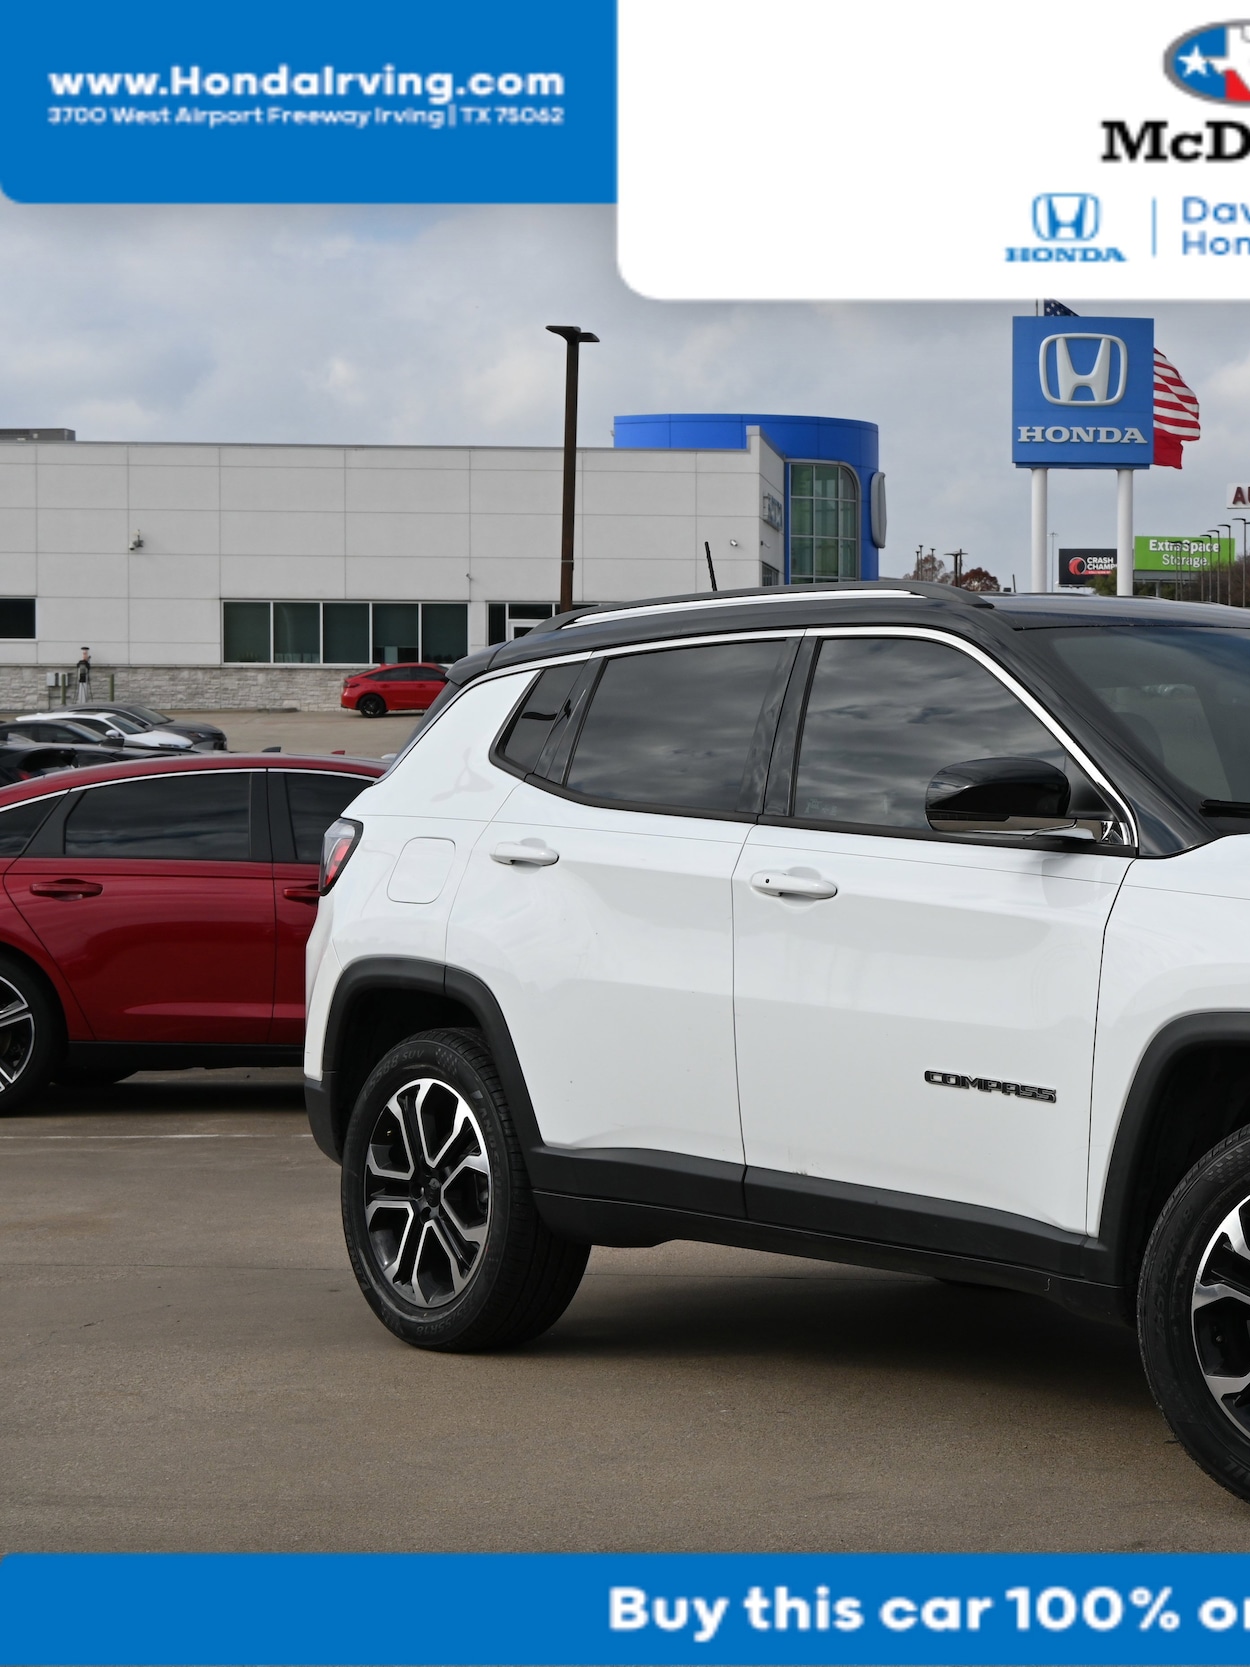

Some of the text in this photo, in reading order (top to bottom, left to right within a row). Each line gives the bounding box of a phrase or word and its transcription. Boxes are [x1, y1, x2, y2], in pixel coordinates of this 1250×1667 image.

[1017, 426, 1148, 444] HONDA
[402, 1049, 425, 1062] SUV
[924, 1070, 1057, 1103] COMPASS
